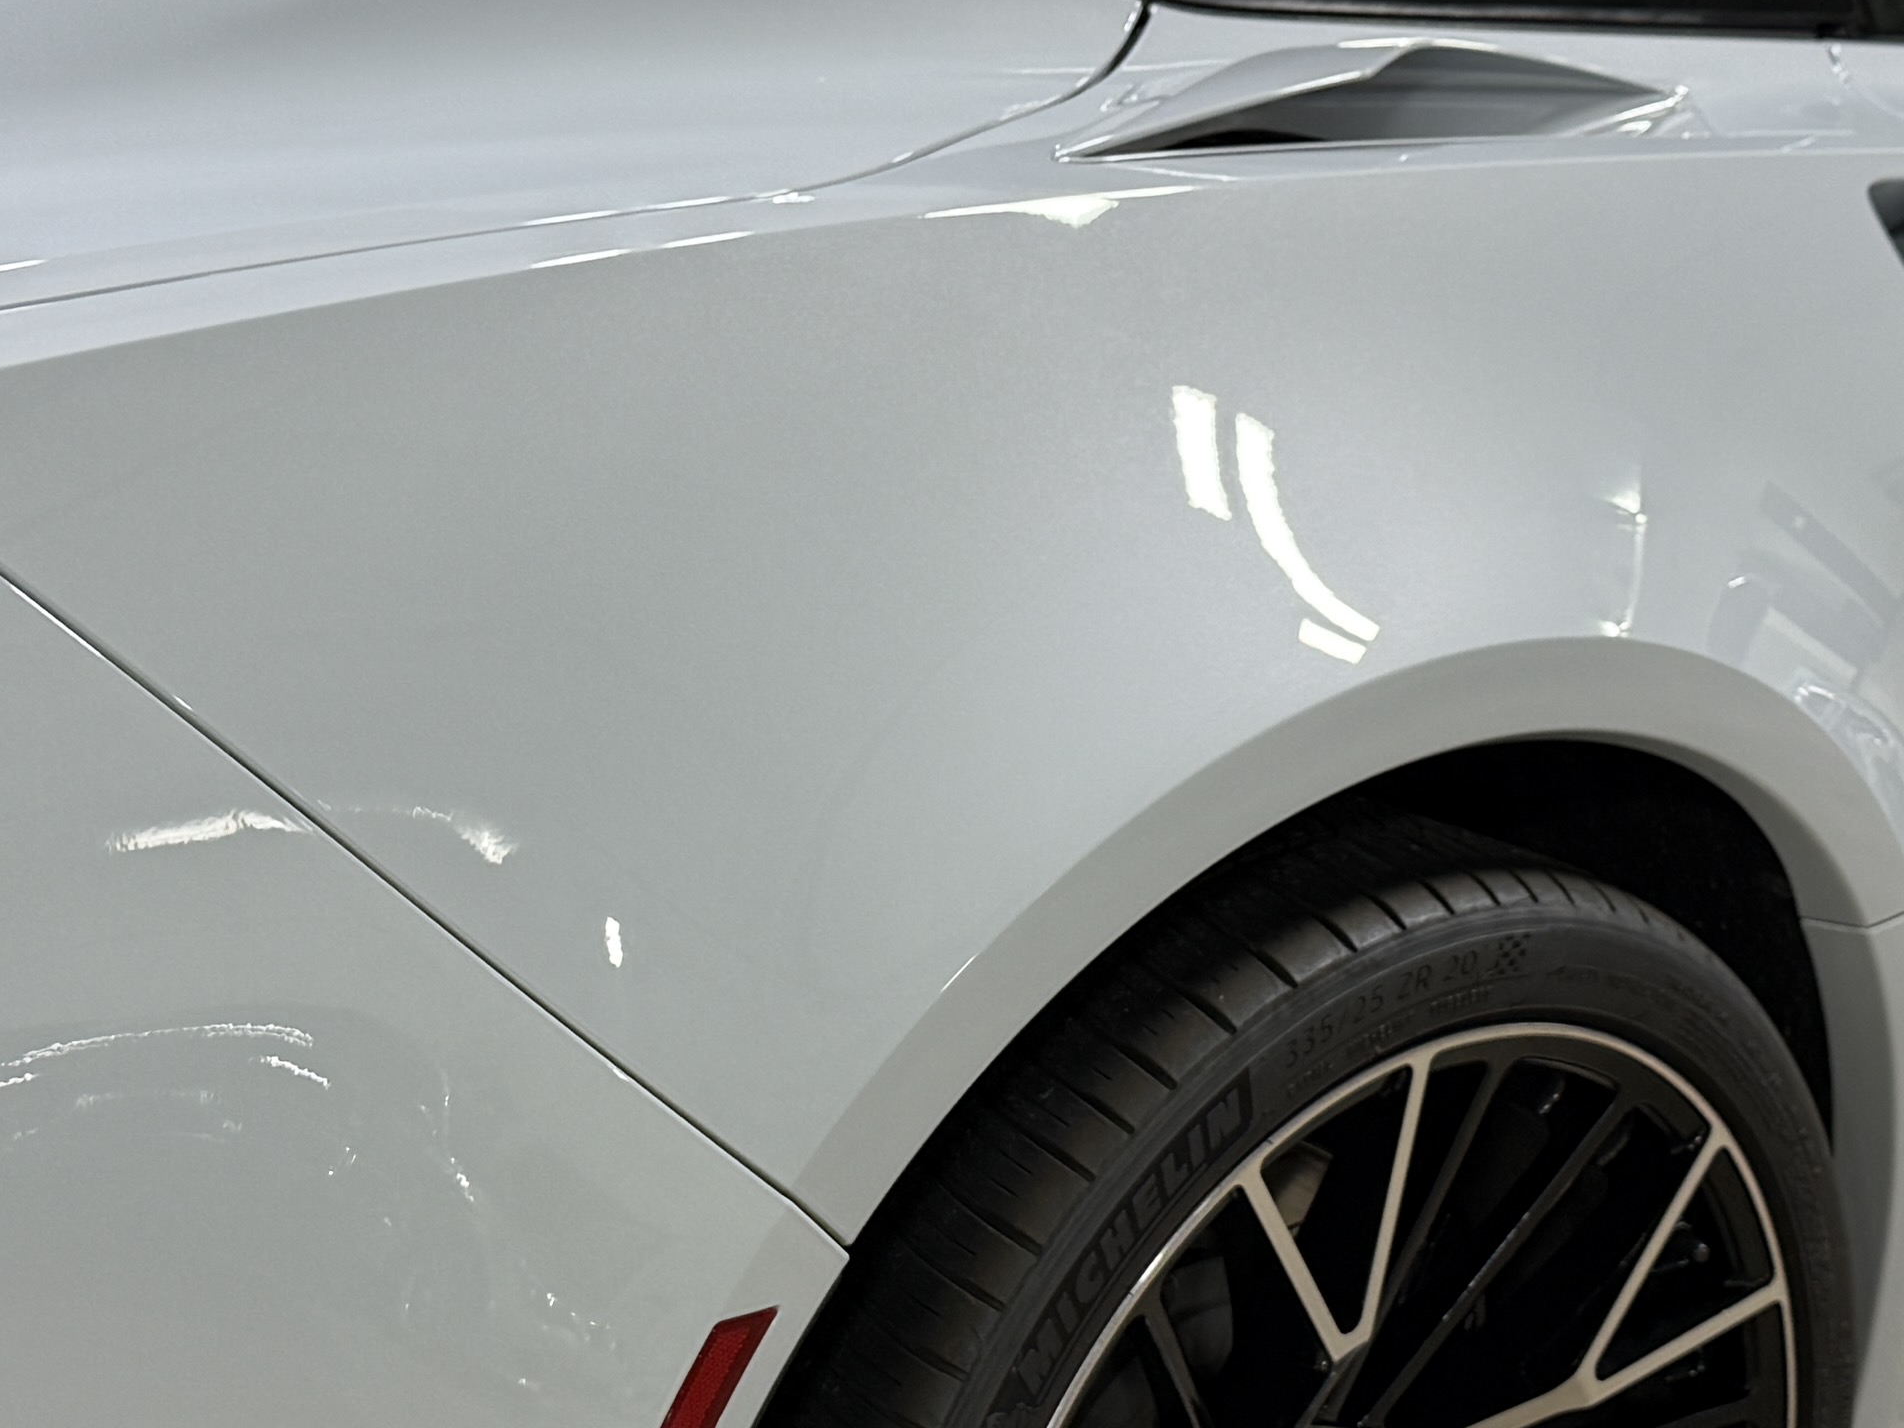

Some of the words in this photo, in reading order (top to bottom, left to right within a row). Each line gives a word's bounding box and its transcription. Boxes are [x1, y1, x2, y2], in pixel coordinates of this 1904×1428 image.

[1285, 983, 1385, 1069] 335/25
[1397, 964, 1433, 1001] ZR
[1442, 949, 1479, 982] 20
[1016, 1085, 1242, 1396] MICHELIN
